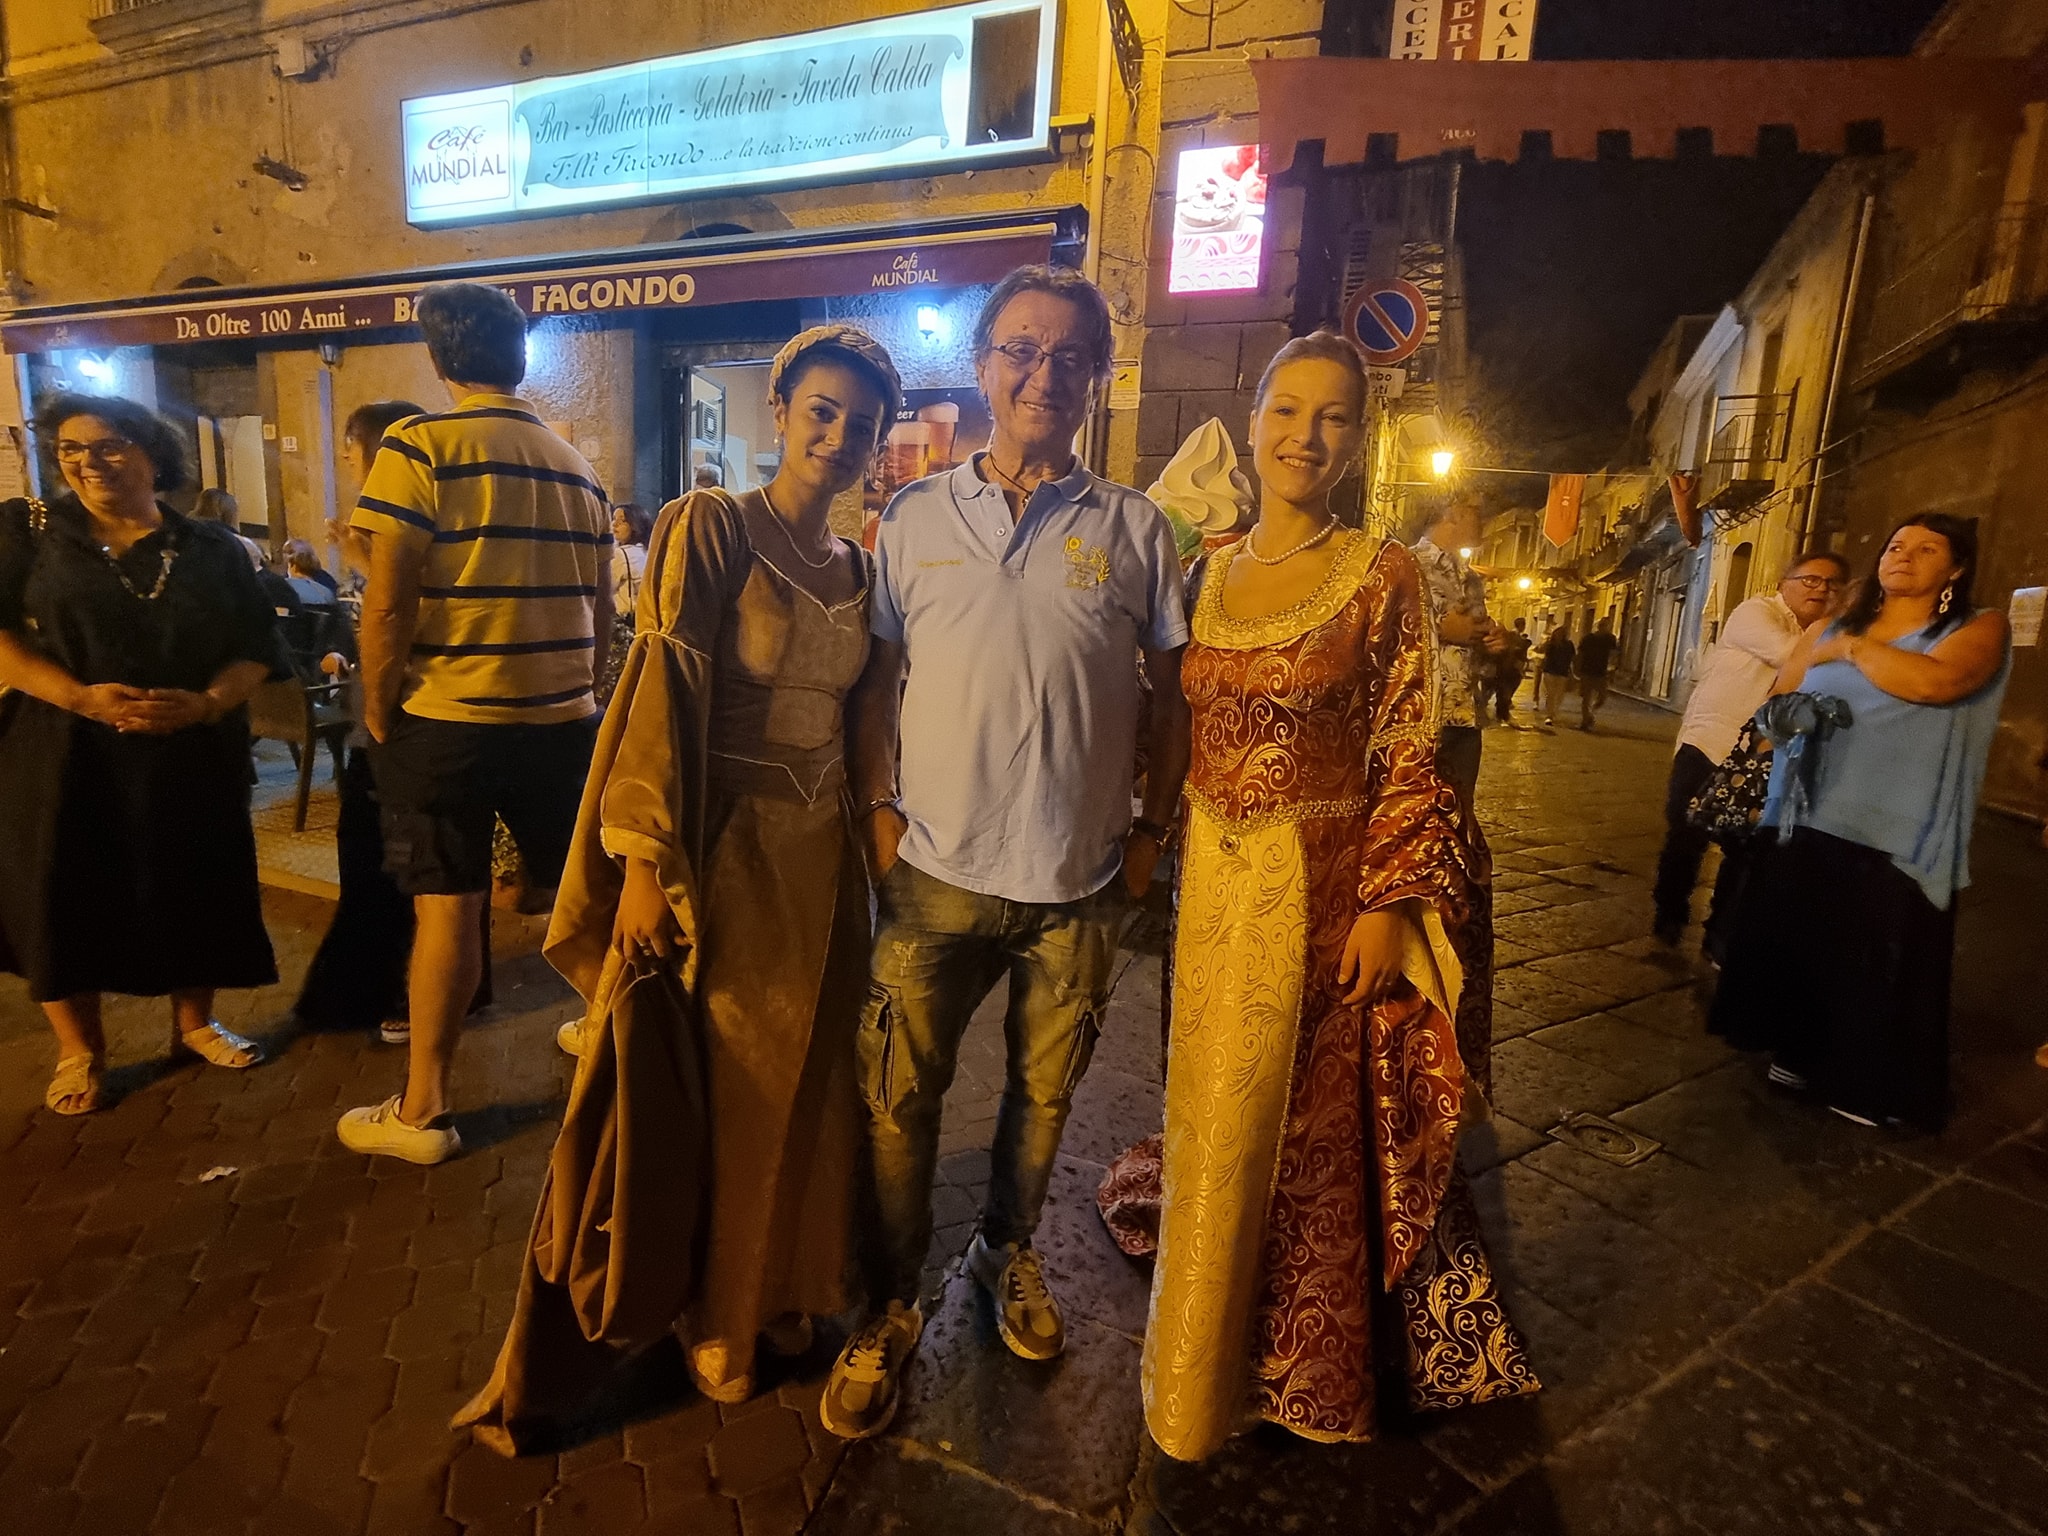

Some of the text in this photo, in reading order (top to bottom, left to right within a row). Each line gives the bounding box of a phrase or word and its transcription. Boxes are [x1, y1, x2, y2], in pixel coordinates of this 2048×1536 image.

[536, 101, 569, 144] Bar
[585, 93, 673, 138] Pasticceria
[694, 73, 774, 121] Gelateria
[793, 58, 861, 106] Tavola
[871, 43, 933, 95] Calda
[604, 144, 704, 175] Facondo
[738, 136, 754, 158] la
[757, 134, 837, 156] tradizione
[839, 125, 913, 145] continua
[411, 153, 507, 188] MUNDIAL
[532, 273, 696, 313] FACONDO
[872, 268, 938, 287] MUNDIAL
[176, 316, 200, 339] Da
[206, 312, 250, 336] Oltre
[260, 309, 291, 333] 100
[300, 304, 346, 329] Anni
